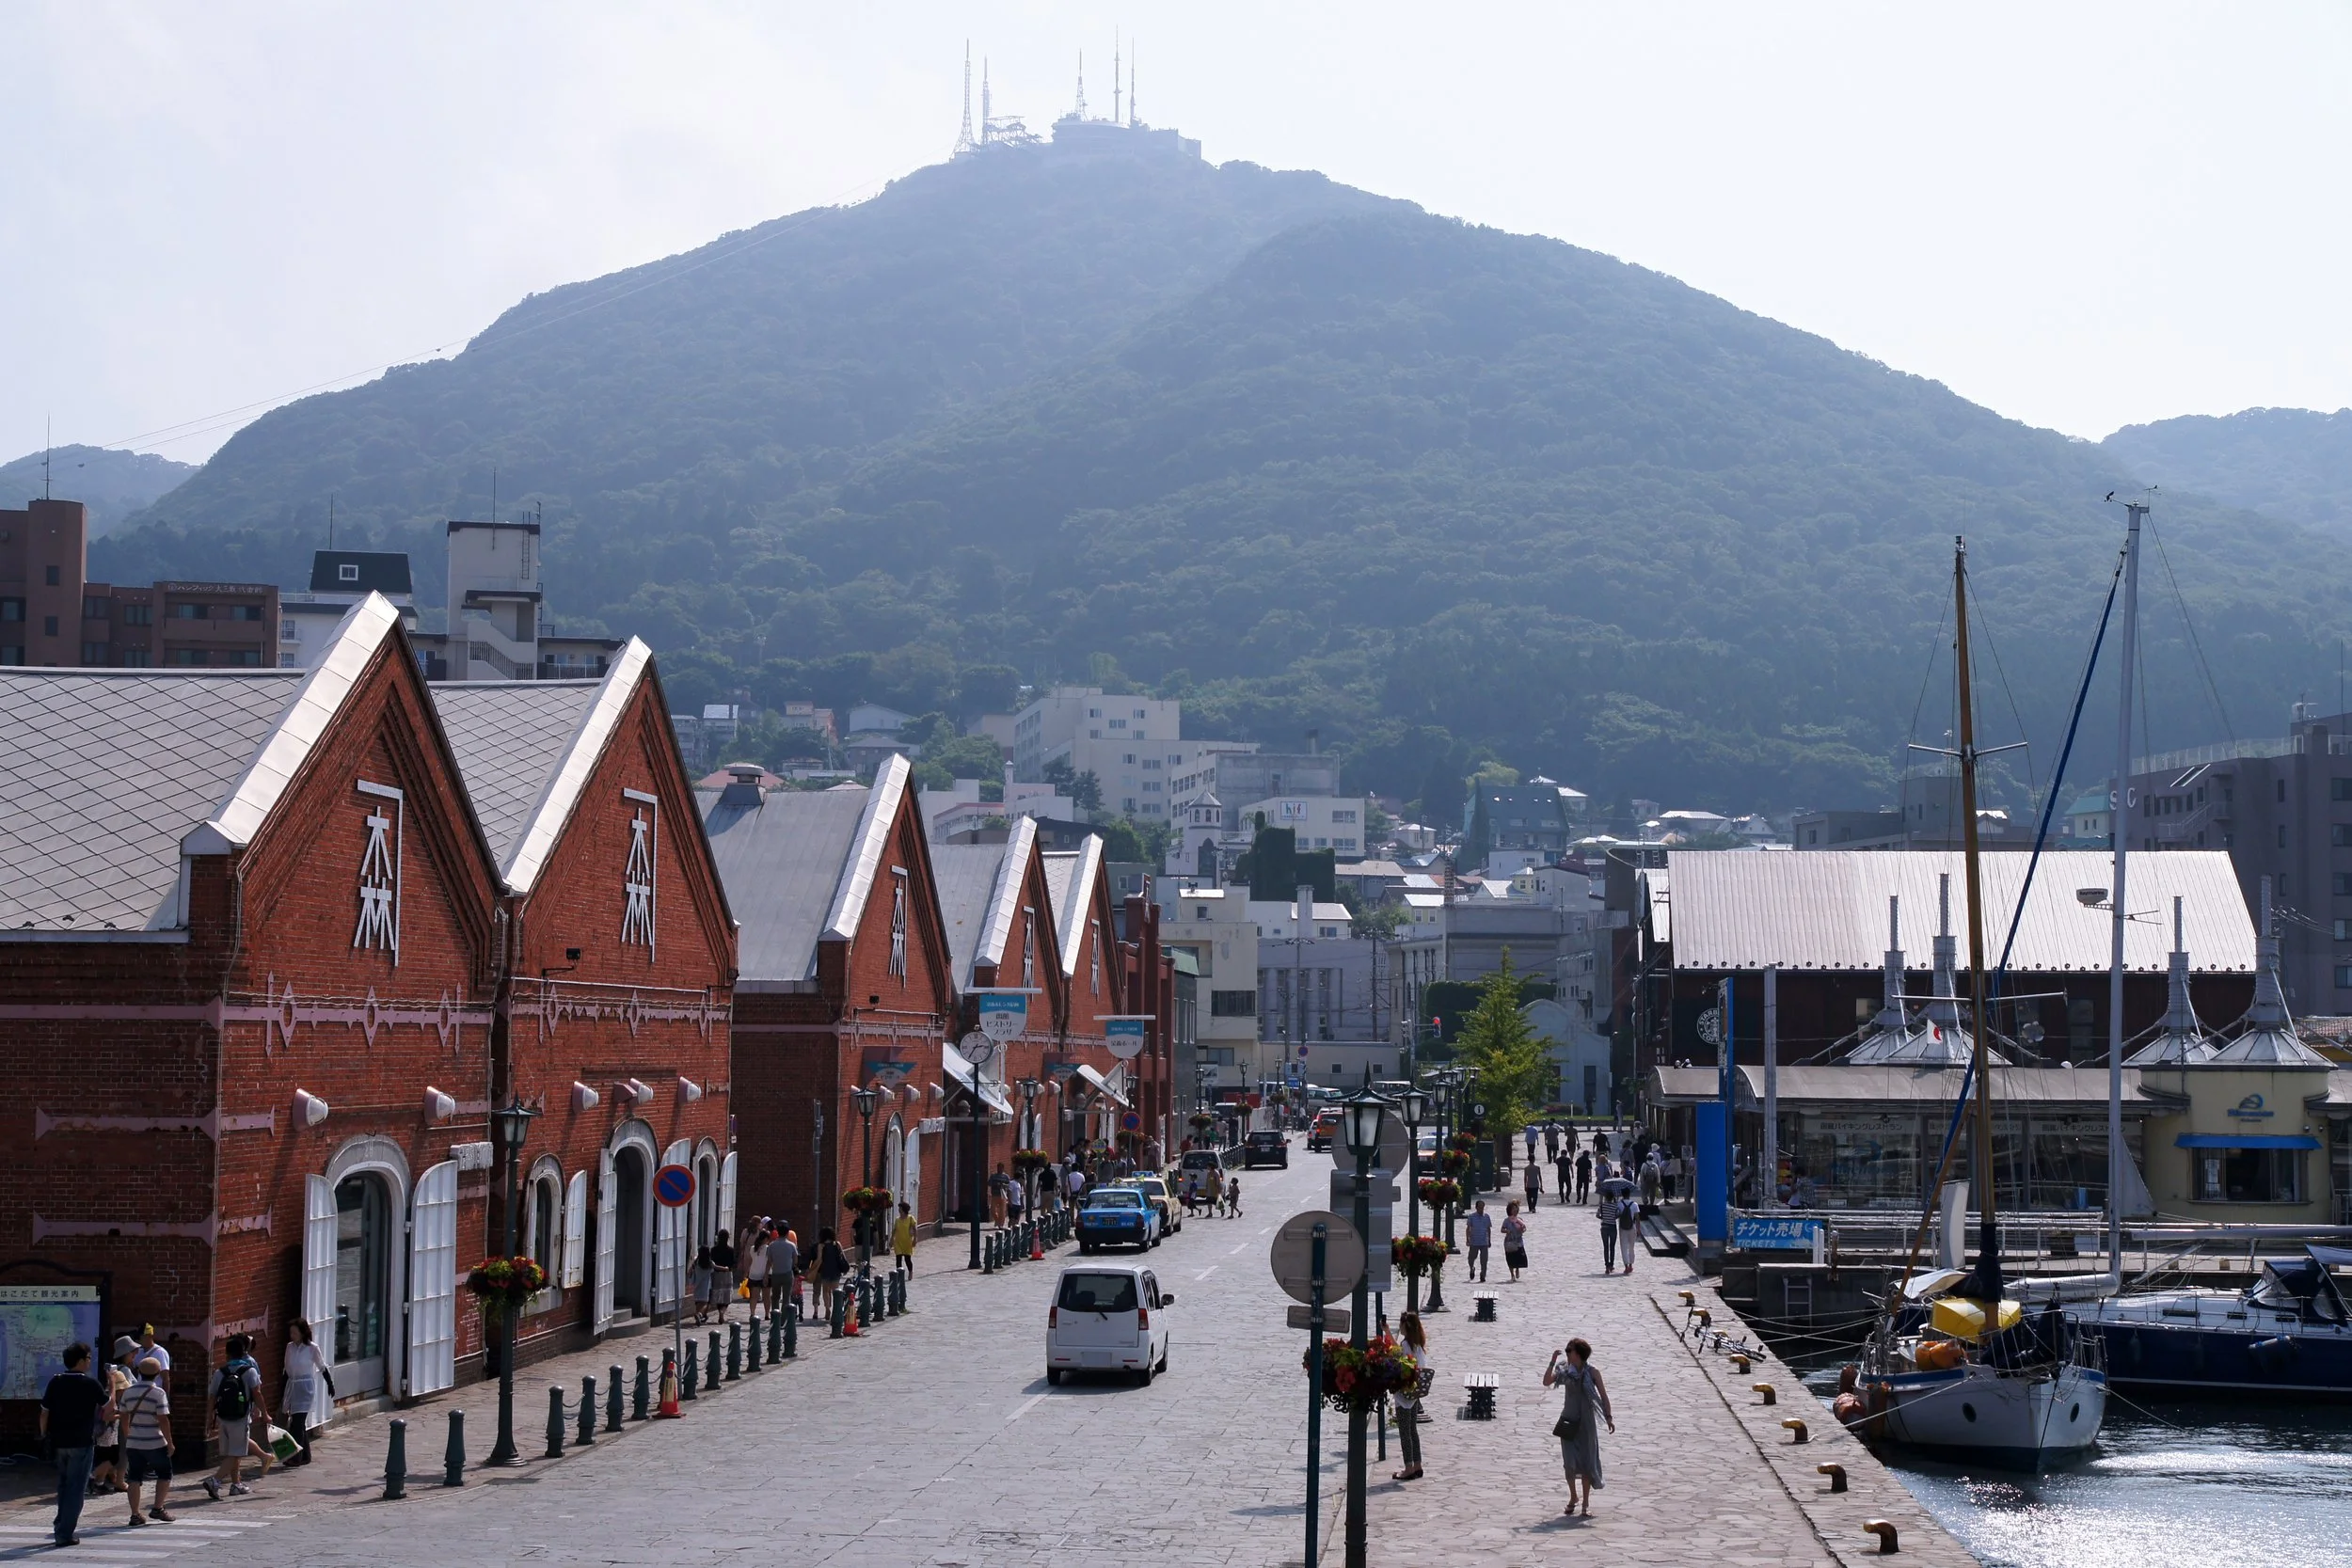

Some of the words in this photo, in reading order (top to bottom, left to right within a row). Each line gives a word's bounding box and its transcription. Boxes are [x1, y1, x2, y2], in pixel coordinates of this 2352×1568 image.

[2109, 788, 2137, 810] SC
[1737, 1222, 1803, 1237] チケット売場
[1737, 1240, 1776, 1248] TICKETS
